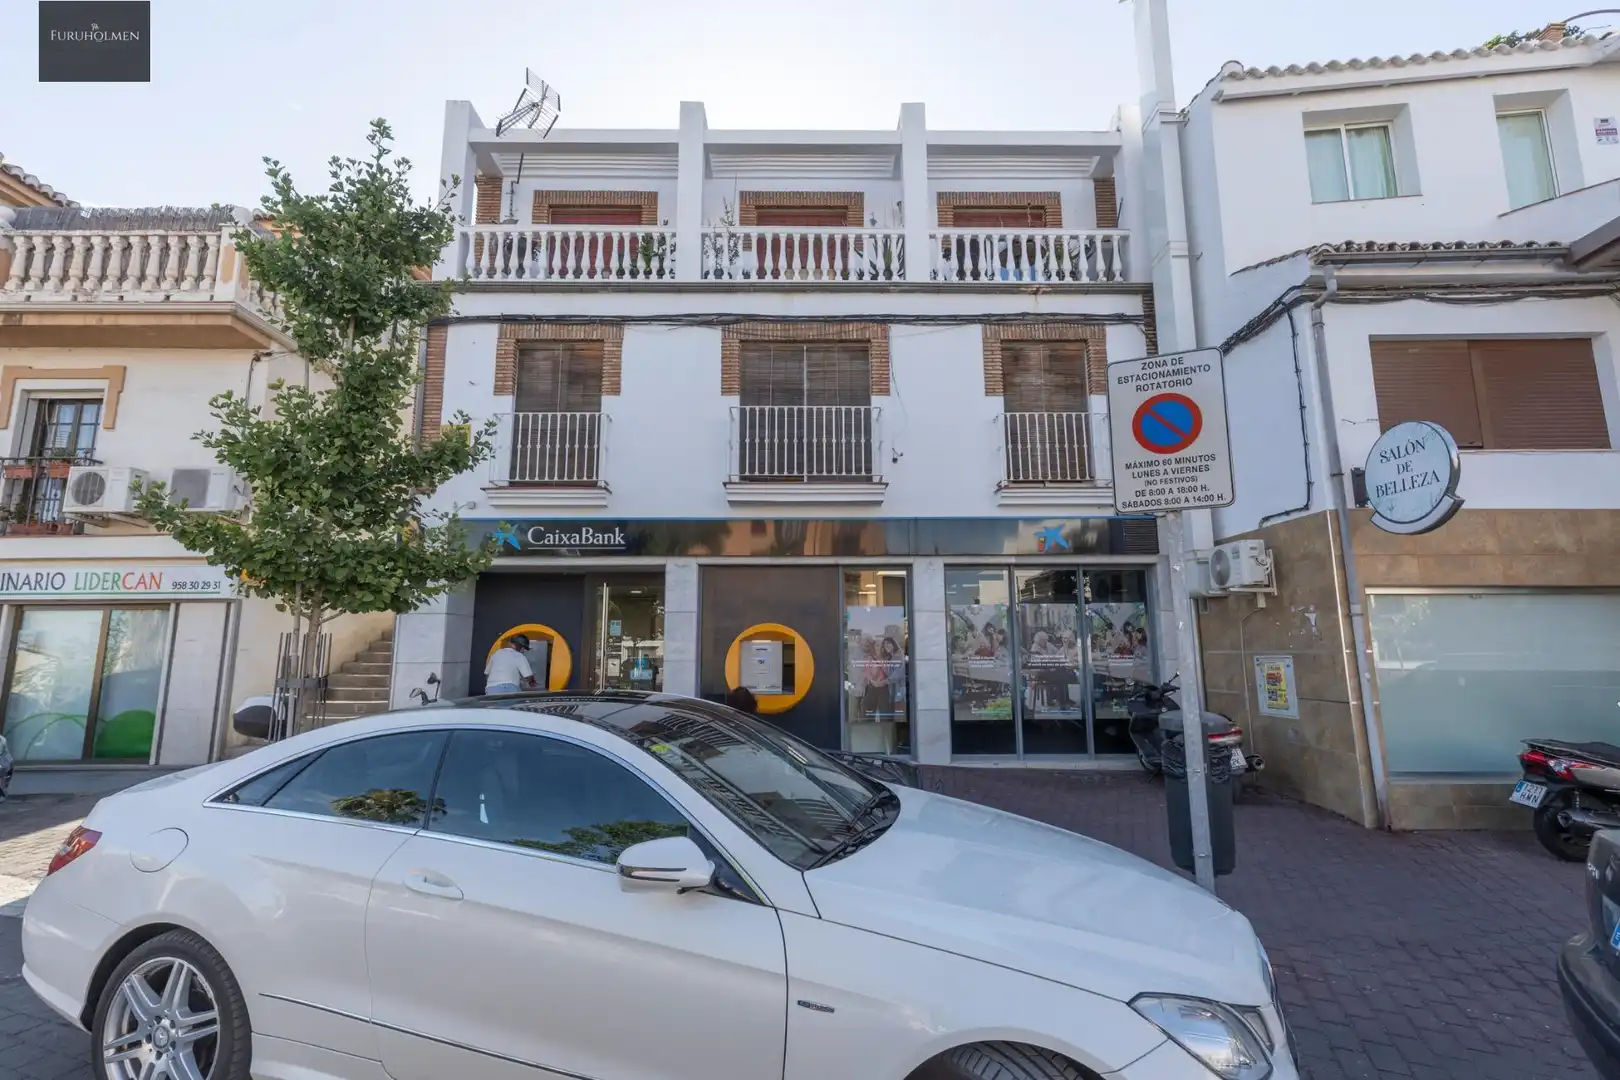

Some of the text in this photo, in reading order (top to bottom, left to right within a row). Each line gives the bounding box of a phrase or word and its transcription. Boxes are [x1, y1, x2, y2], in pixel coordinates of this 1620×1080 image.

[1141, 356, 1185, 371] ZONA DE
[1117, 363, 1211, 385] ESTACIONAMIENTO
[1135, 377, 1193, 393] ROTATORIO
[1379, 436, 1427, 464] SALÓN
[1162, 458, 1173, 466] 60
[1174, 453, 1216, 465] MINUTOS
[1132, 464, 1210, 479] LUNES A VIERNES
[1396, 460, 1414, 475] DE
[1144, 475, 1198, 487] (NO FESTIVOS)
[1375, 469, 1441, 498] BELLEZA
[1135, 484, 1210, 498] DE 8:00 A 18:00 H.
[1164, 496, 1182, 505] 8:00
[1183, 495, 1190, 504] A
[1193, 494, 1215, 503] 14:00
[1217, 493, 1227, 501] H.
[527, 525, 626, 545] CaixaBank
[74, 571, 163, 591] LIDERCAN
[171, 580, 187, 590] 958
[188, 580, 200, 590] 30
[200, 580, 211, 590] 29
[211, 580, 221, 590] 31
